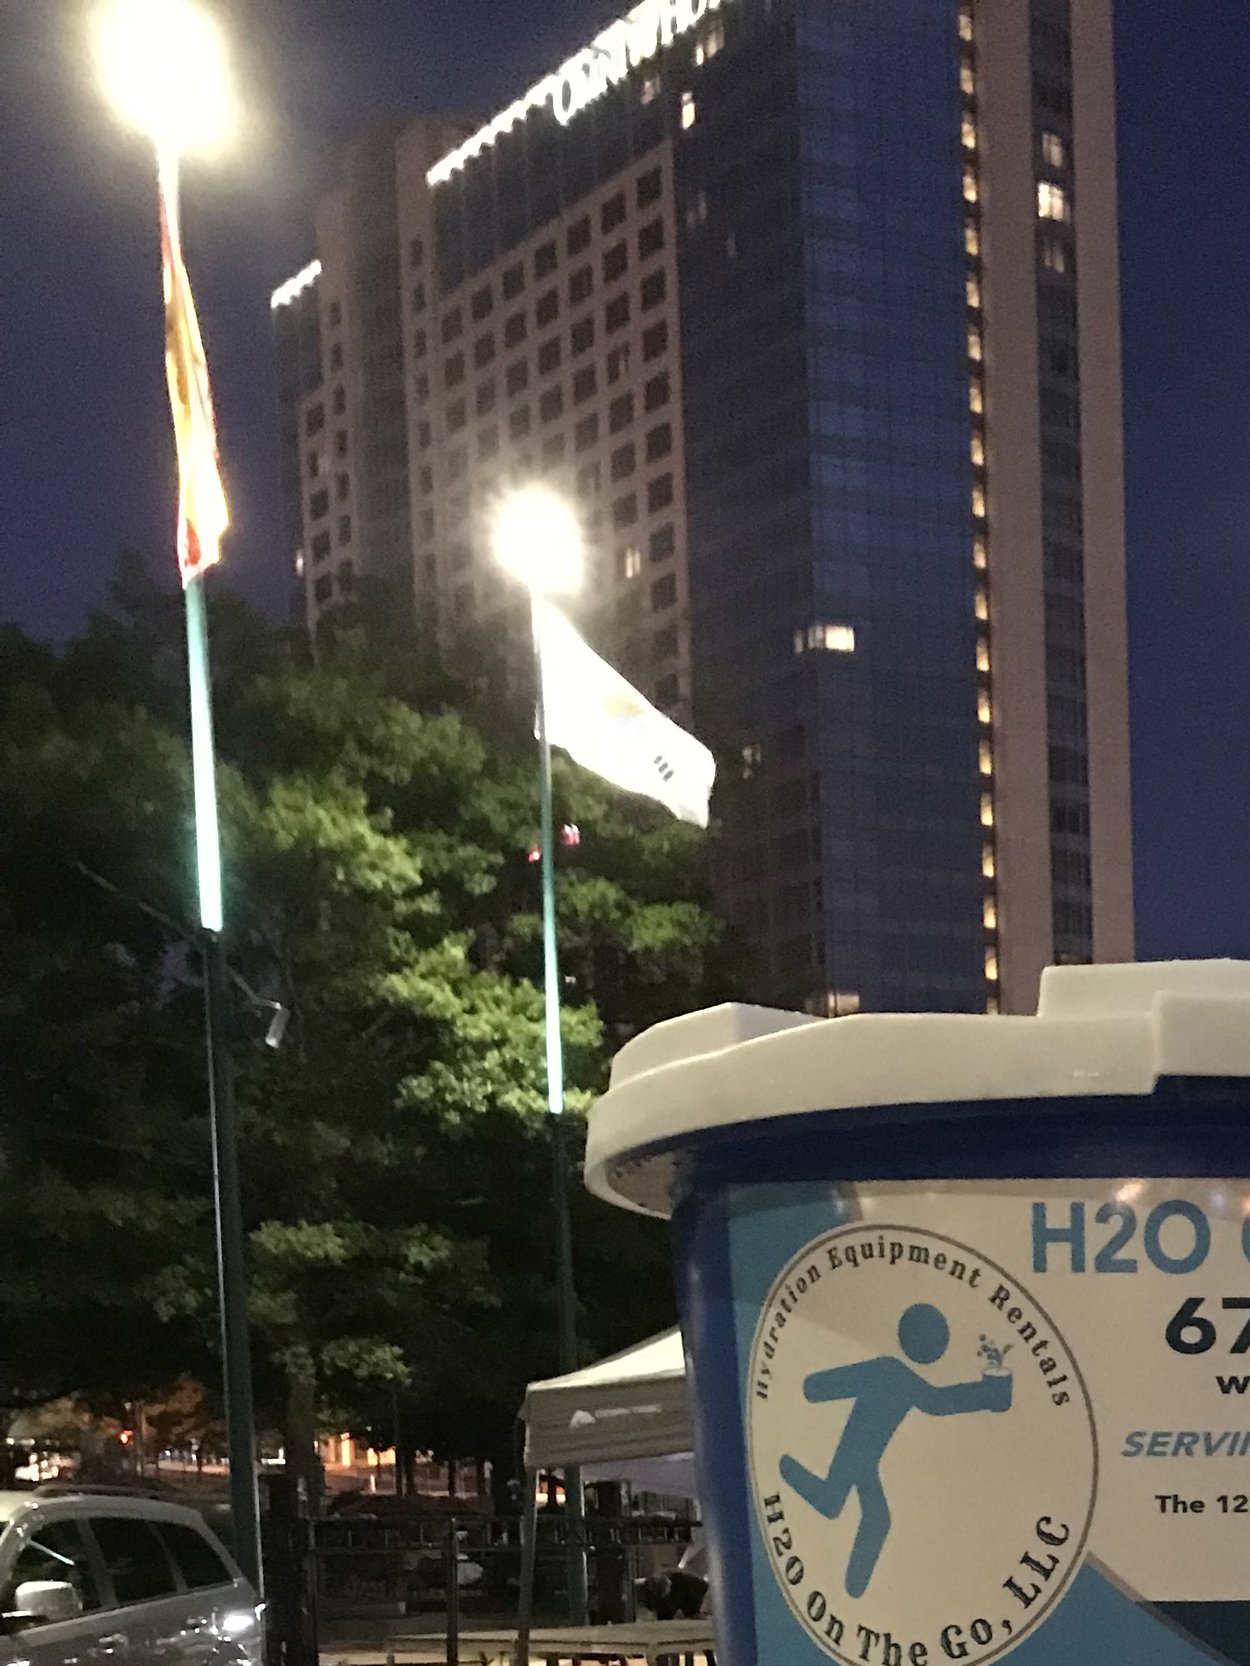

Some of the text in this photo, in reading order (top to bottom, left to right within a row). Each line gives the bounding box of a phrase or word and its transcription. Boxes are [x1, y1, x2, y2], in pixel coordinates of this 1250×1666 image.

[1031, 1199, 1211, 1275] H2O
[756, 1235, 1071, 1407] Hydration Equipment Rentals
[1155, 1494, 1205, 1514] The
[763, 1491, 805, 1586] H2O
[806, 1590, 845, 1647] On
[940, 1617, 1013, 1660] Go,
[1002, 1515, 1070, 1610] LLC
